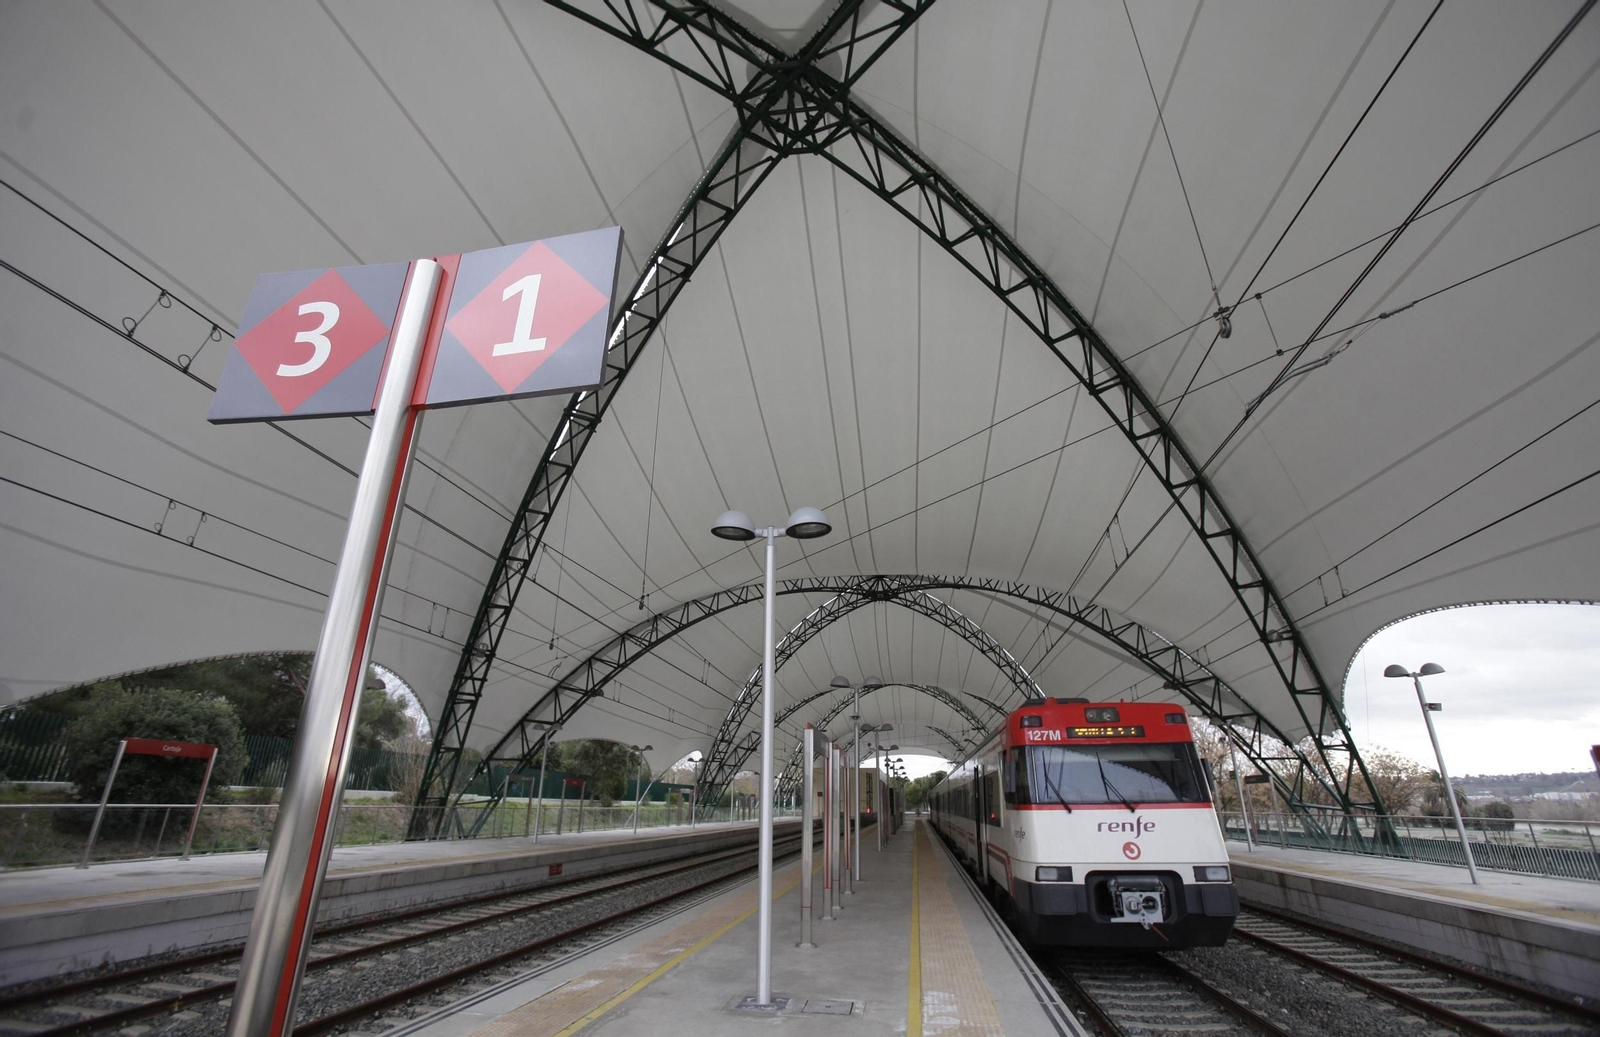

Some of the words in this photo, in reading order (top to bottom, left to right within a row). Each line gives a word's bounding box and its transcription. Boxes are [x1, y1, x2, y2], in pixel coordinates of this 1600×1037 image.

[276, 300, 341, 377] 3
[491, 273, 548, 357] 1
[1027, 730, 1061, 741] 127M
[1097, 815, 1156, 839] renfe
